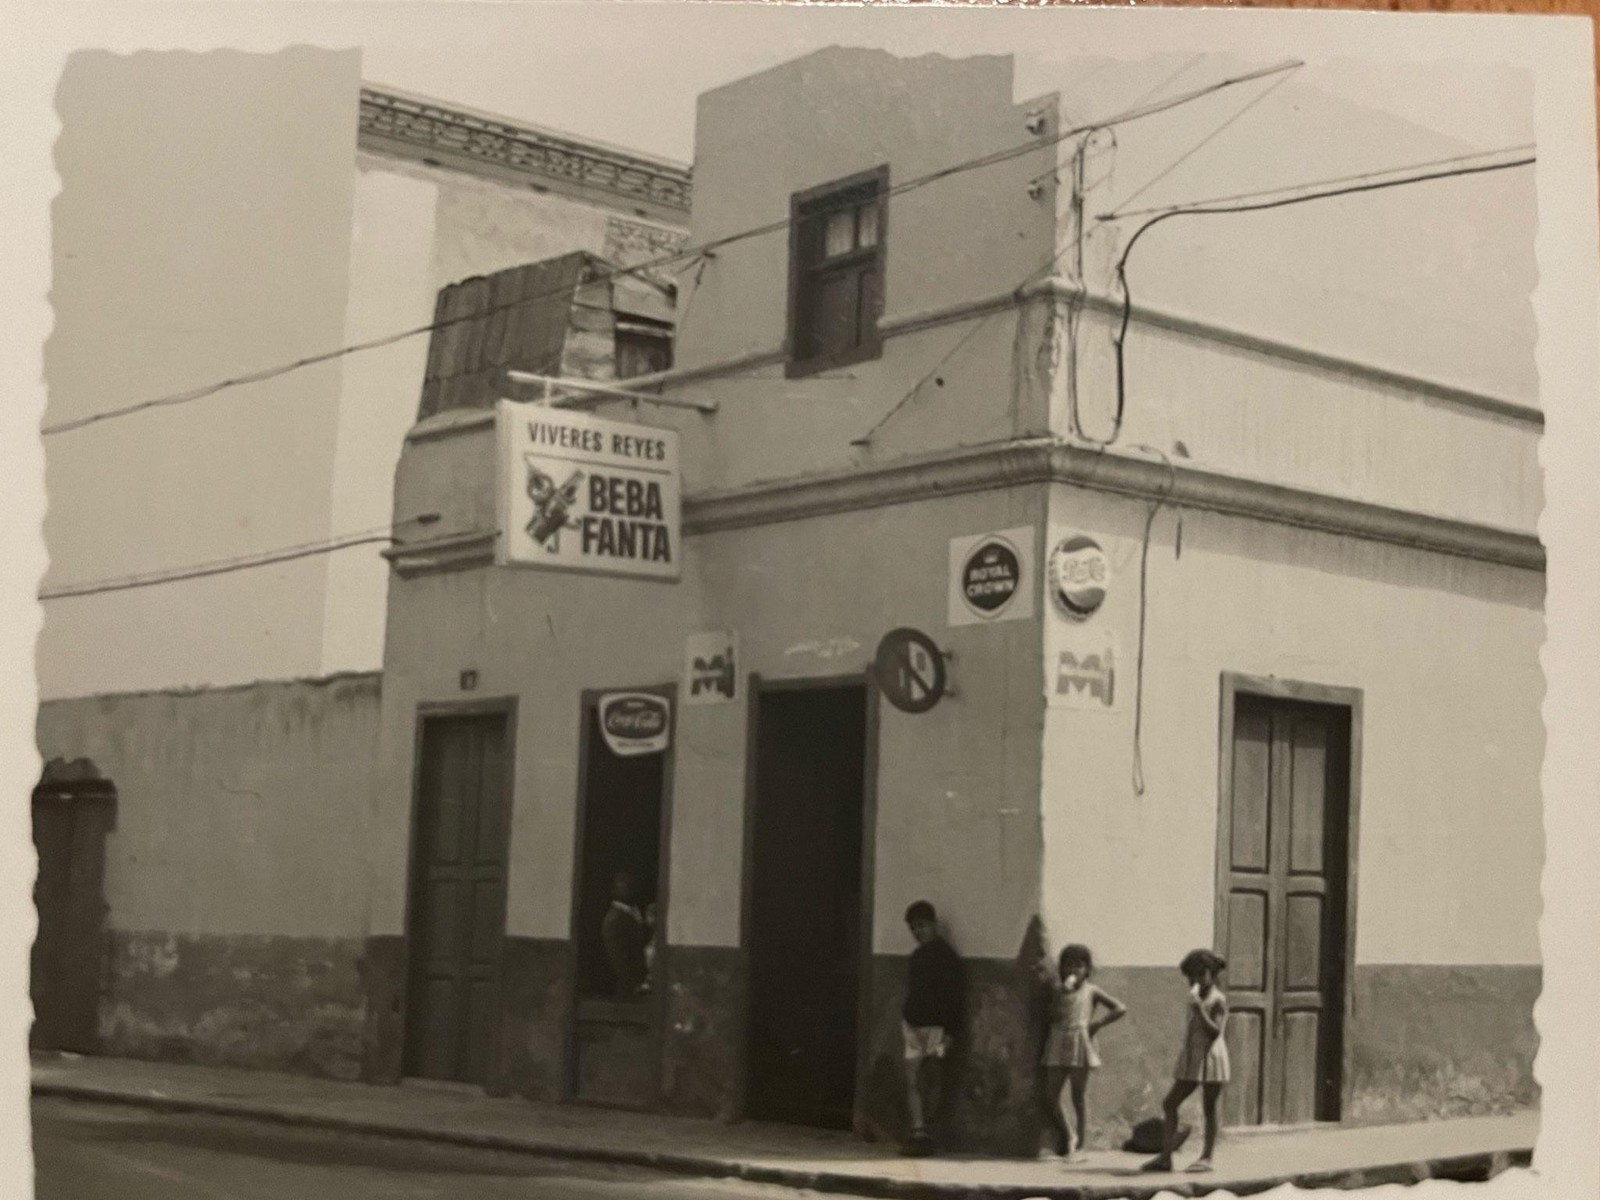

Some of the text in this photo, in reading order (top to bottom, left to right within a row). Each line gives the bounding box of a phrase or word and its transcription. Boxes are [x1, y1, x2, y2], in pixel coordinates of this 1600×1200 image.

[528, 422, 665, 461] VIVERES REYES
[589, 474, 663, 521] BEBA
[582, 516, 671, 563] FANTA
